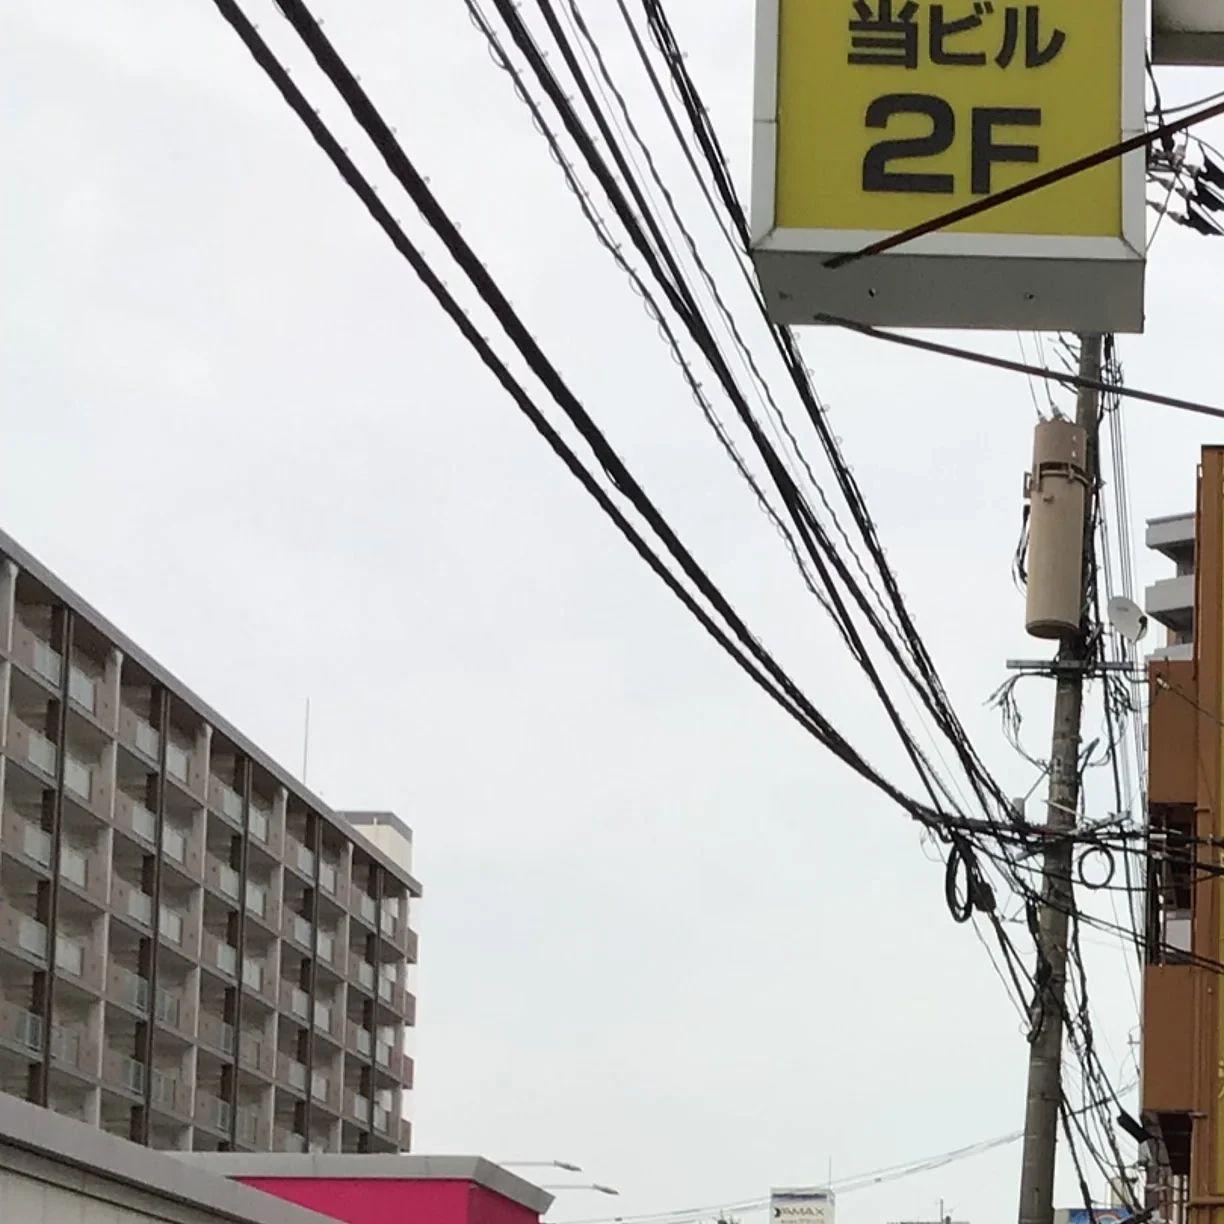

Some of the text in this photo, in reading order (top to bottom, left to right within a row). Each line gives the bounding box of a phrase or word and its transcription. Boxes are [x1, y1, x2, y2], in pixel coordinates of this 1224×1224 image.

[847, 0, 1066, 70] 当ビル
[862, 93, 1041, 195] 2F
